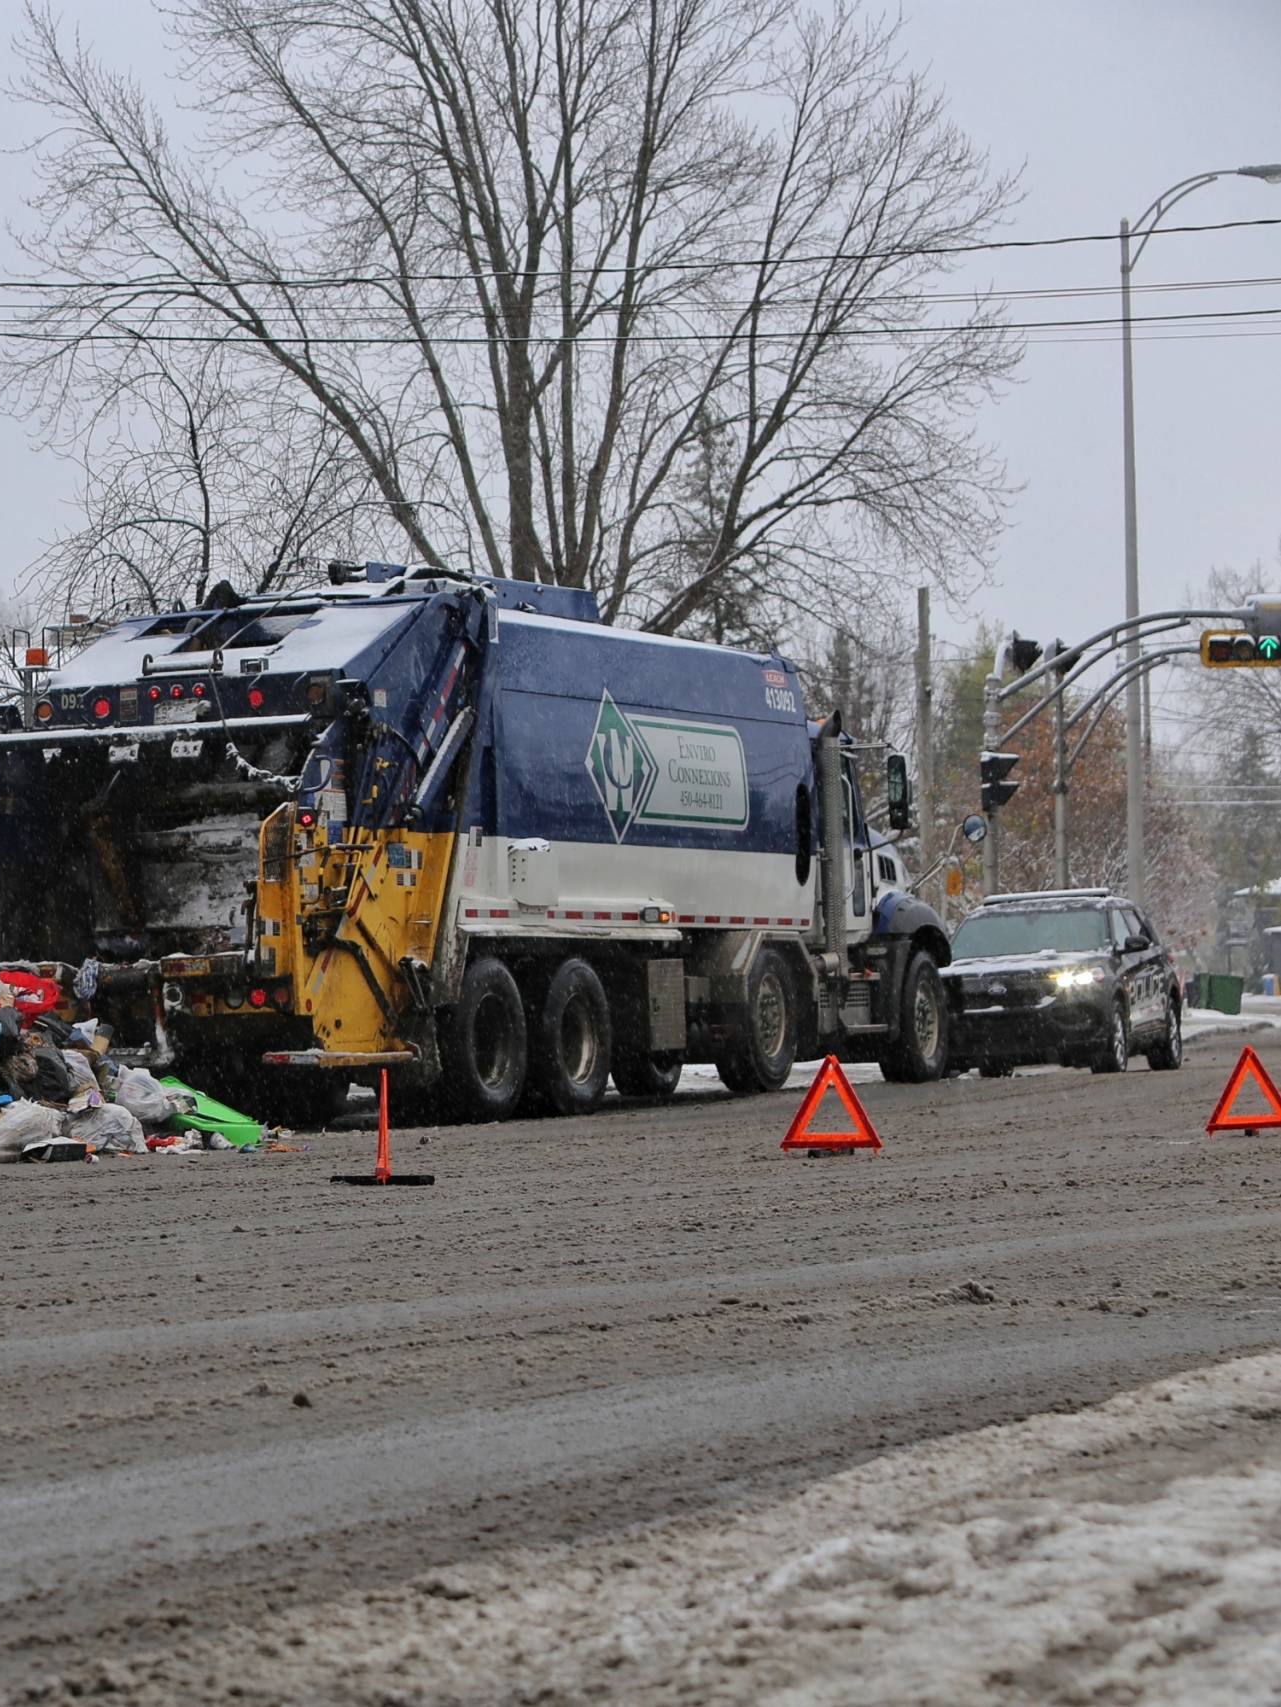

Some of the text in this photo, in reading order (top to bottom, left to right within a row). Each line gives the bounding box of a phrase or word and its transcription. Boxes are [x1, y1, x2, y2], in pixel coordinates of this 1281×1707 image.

[765, 686, 796, 712] 413092
[677, 735, 716, 762] ENVIRO
[668, 758, 731, 788] CONNEXIONS
